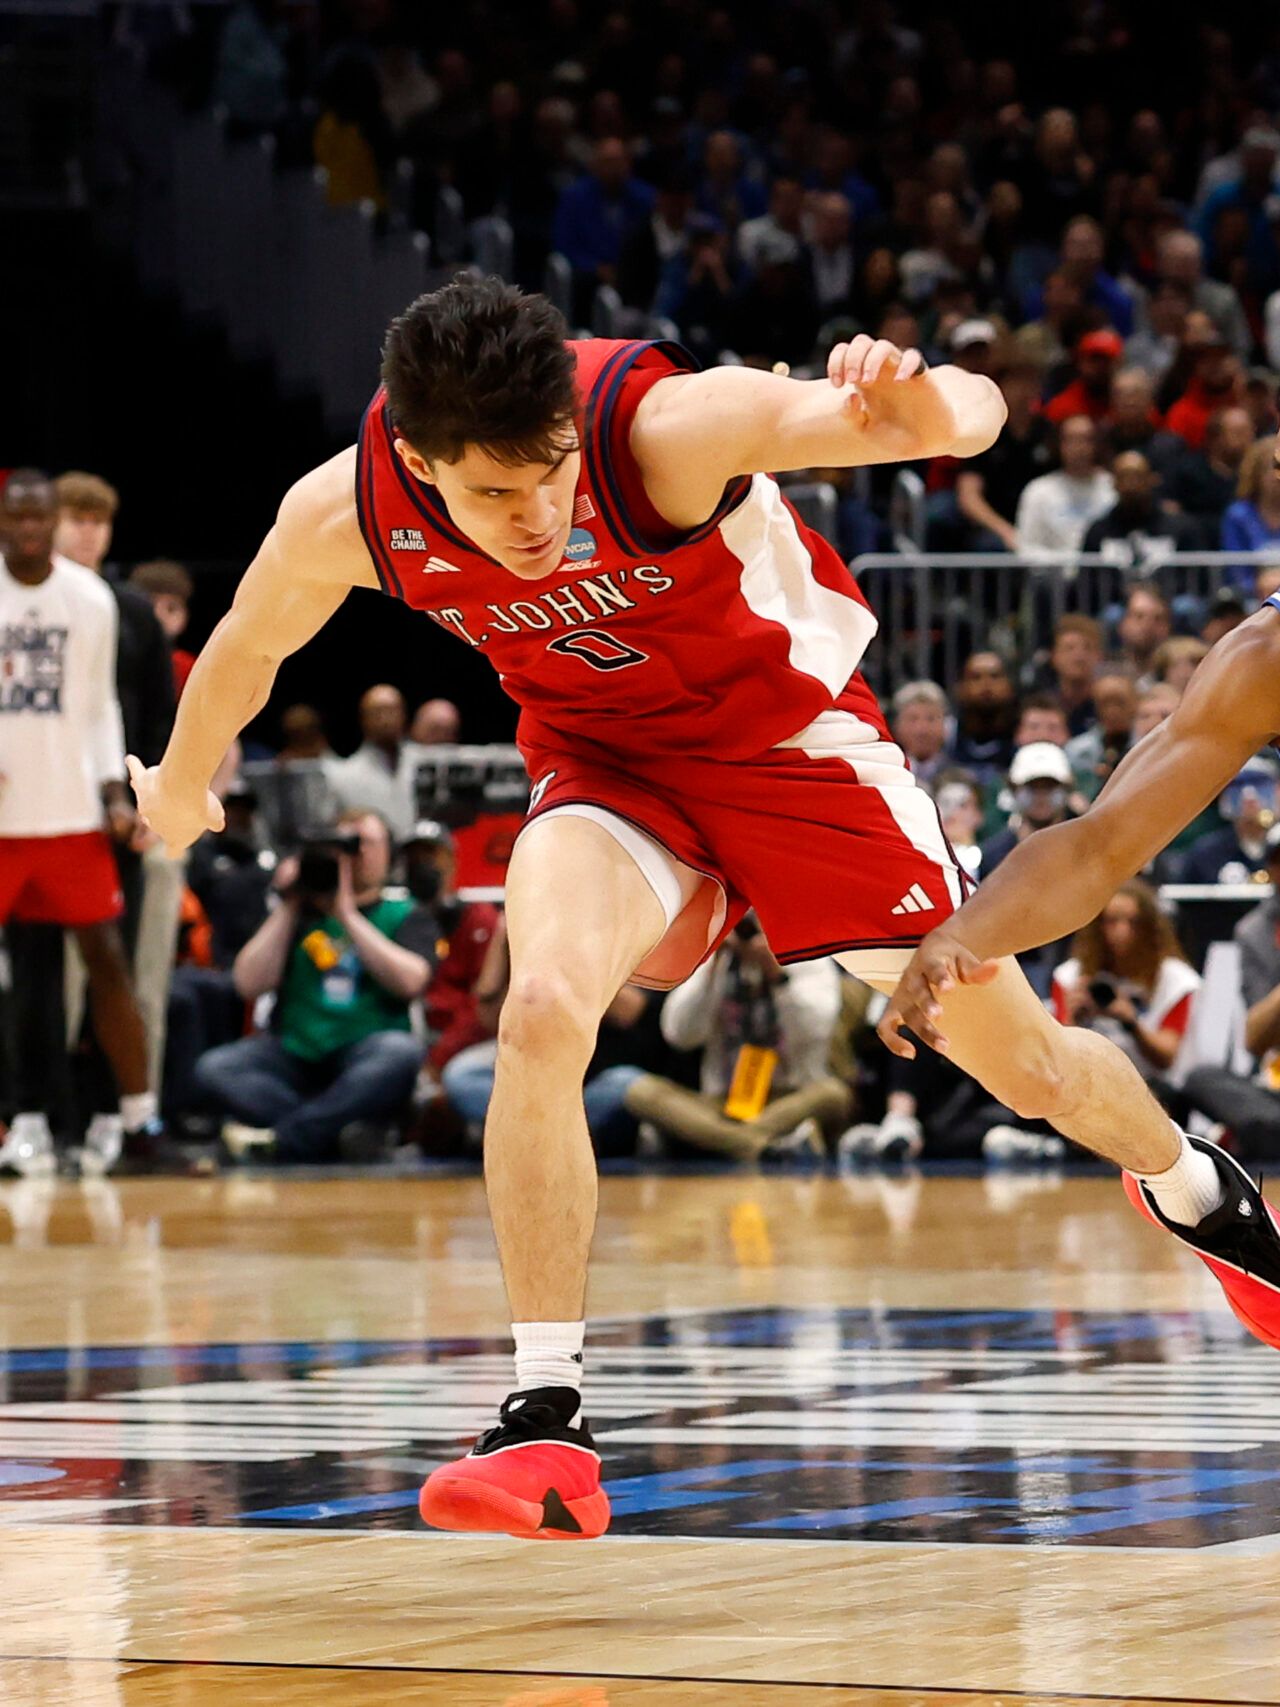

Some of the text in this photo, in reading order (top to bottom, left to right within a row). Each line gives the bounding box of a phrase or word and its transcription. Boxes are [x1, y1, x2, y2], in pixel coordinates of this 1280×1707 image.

[391, 528, 424, 540] BE THE
[390, 539, 428, 551] CHANGE
[563, 541, 596, 555] NCAA
[486, 565, 675, 633] JOHN'S
[546, 629, 650, 672] 0
